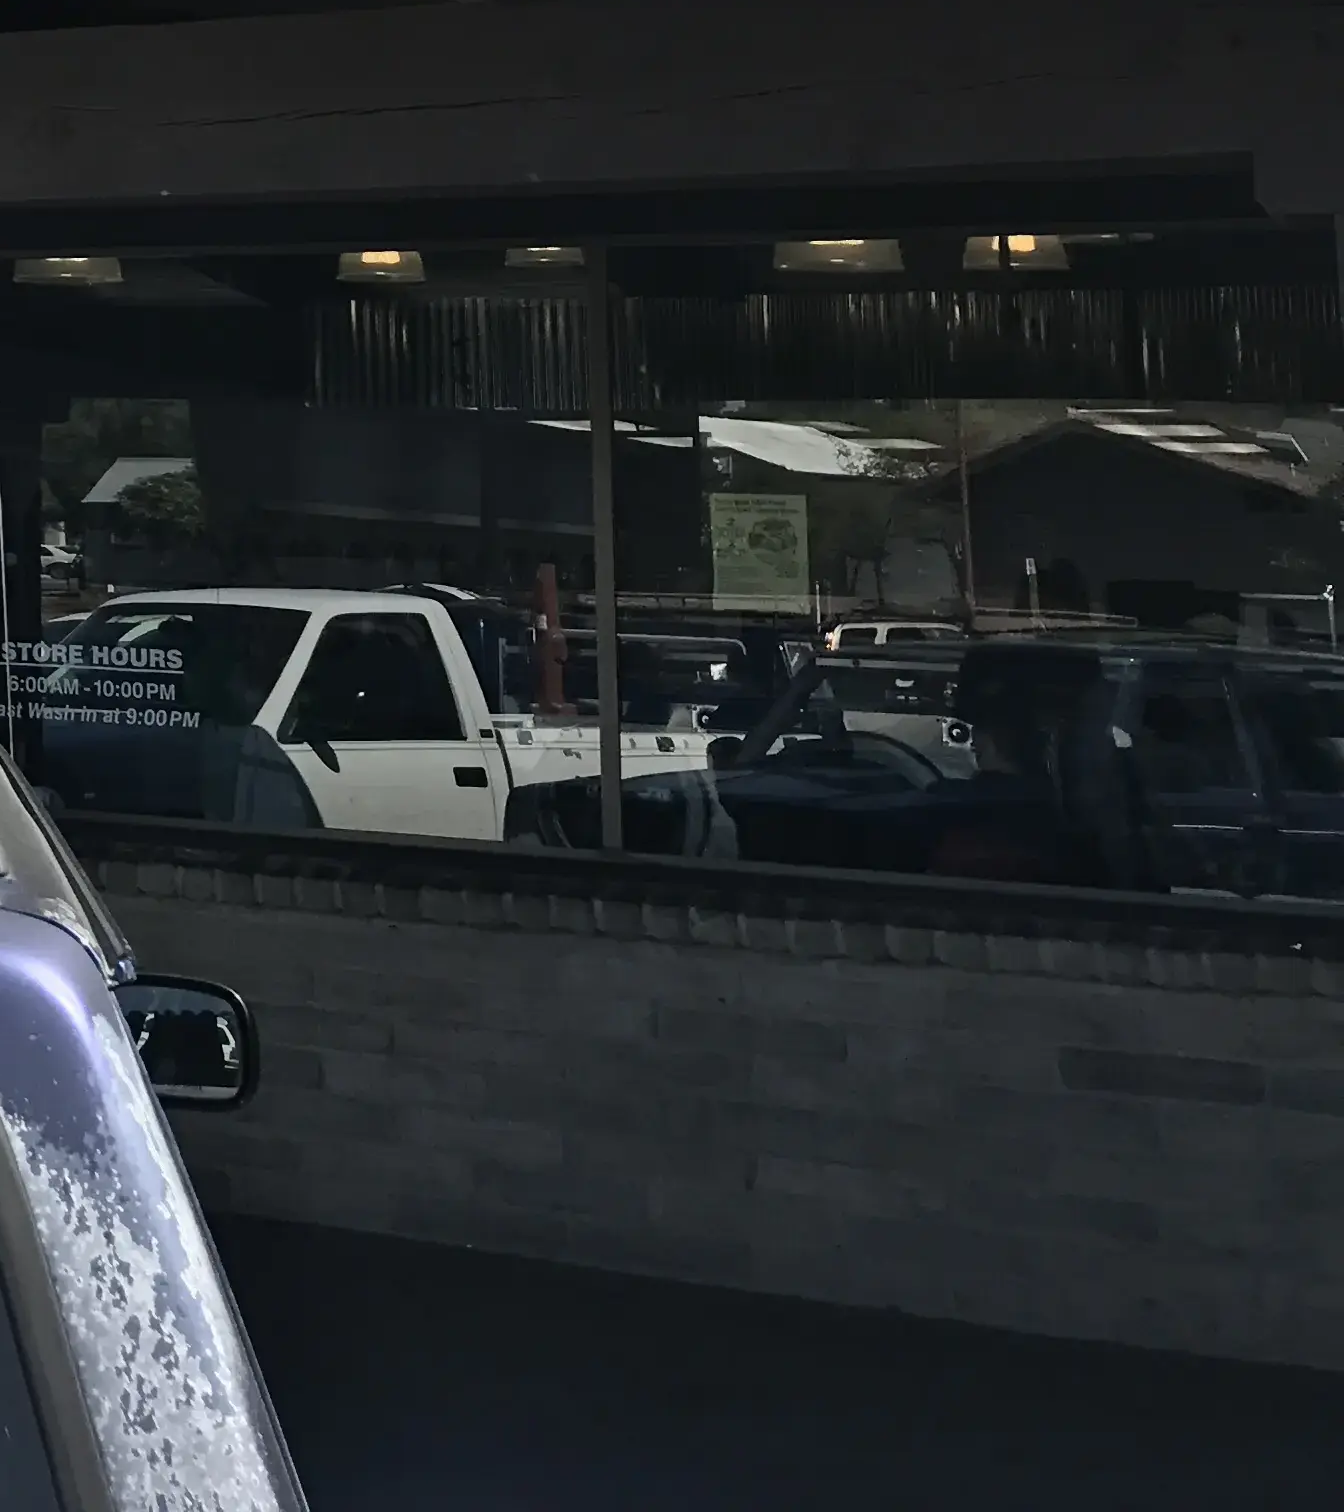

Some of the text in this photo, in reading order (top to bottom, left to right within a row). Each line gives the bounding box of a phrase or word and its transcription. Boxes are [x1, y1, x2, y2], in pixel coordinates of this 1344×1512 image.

[1, 641, 183, 669] STORE HOURS
[28, 702, 75, 721] Wash
[80, 705, 98, 722] in
[103, 708, 120, 724] at
